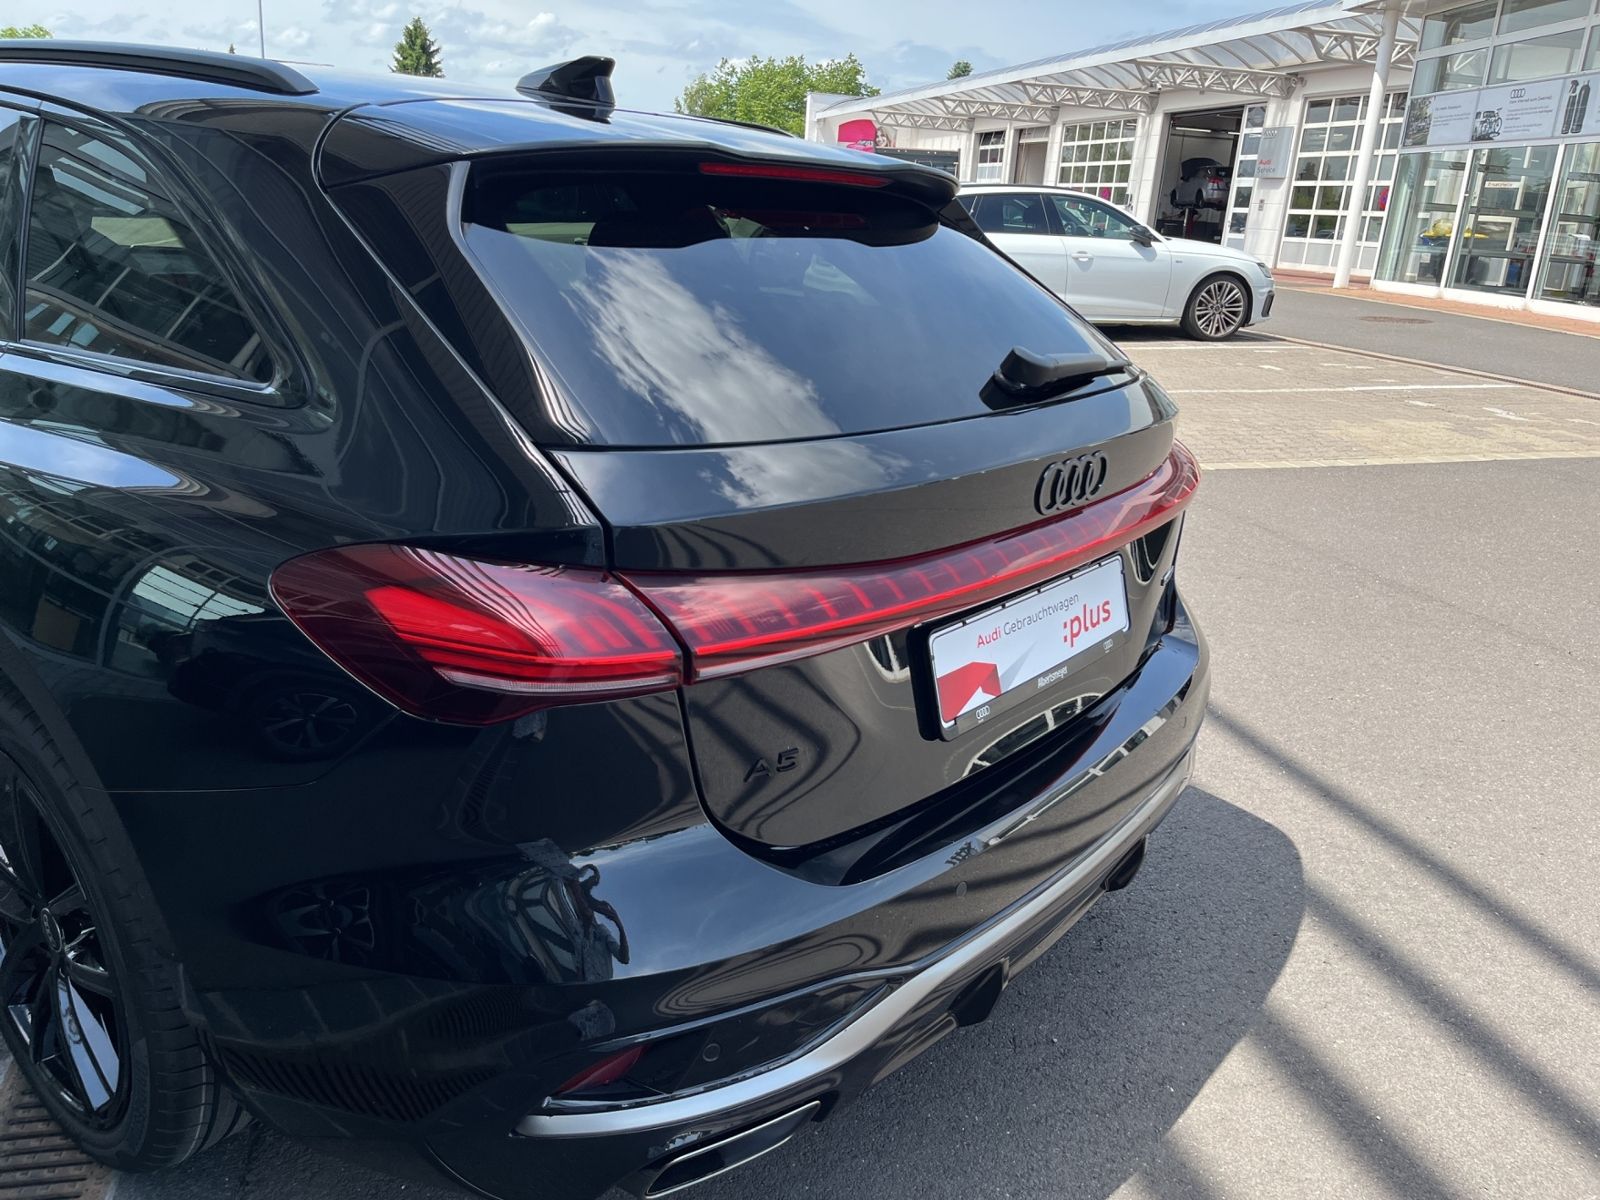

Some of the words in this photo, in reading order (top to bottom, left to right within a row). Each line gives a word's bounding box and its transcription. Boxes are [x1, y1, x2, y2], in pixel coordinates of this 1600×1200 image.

[977, 626, 1001, 648] Audi
[1003, 594, 1080, 635] Gebrauchtwagen
[1063, 599, 1111, 648] :plus
[743, 747, 799, 782] A5
